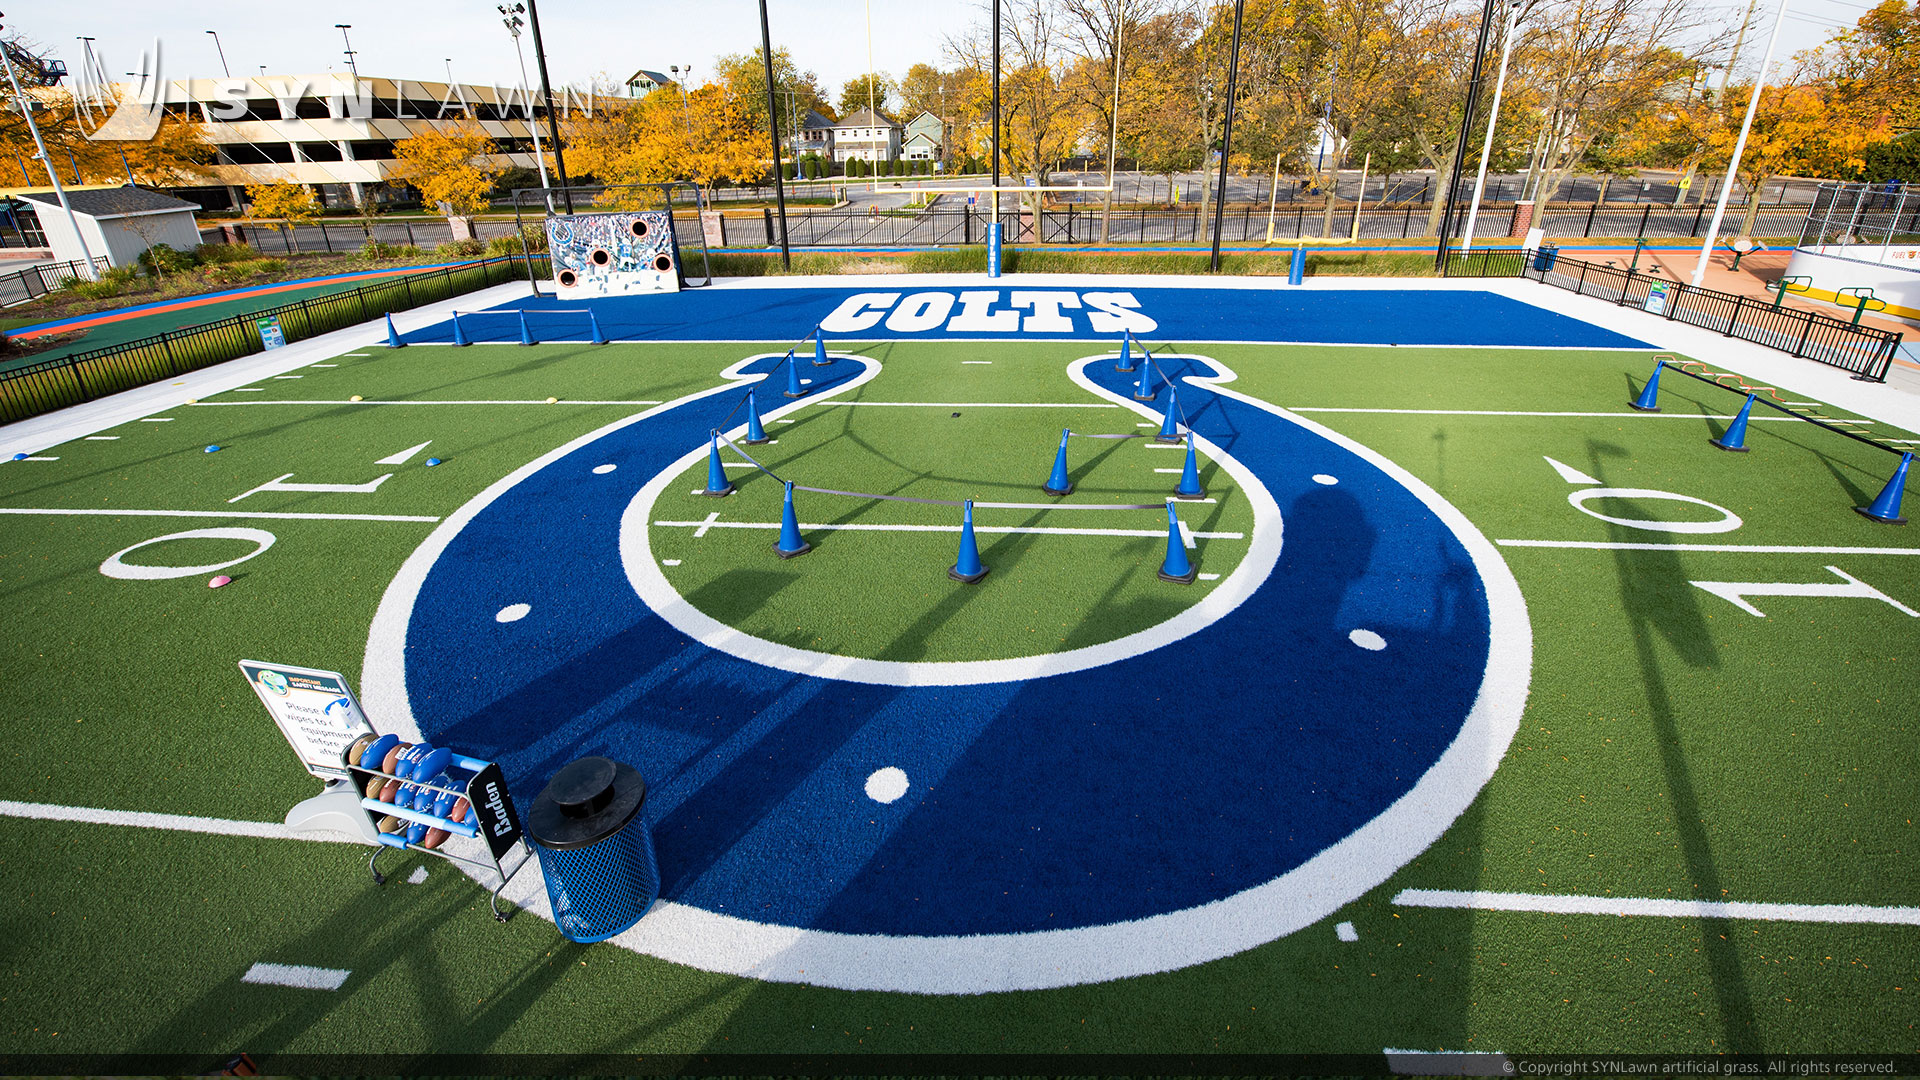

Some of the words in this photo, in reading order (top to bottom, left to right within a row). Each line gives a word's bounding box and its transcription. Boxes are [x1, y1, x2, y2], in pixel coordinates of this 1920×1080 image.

[819, 290, 1159, 333] COLTS
[288, 676, 322, 686] IMPORTANT
[312, 684, 343, 694] MESSAGE
[285, 701, 320, 715] Please
[285, 713, 315, 726] wipes
[316, 717, 328, 726] to
[300, 726, 355, 740] equipment
[306, 736, 340, 748] before
[485, 781, 513, 837] Baden
